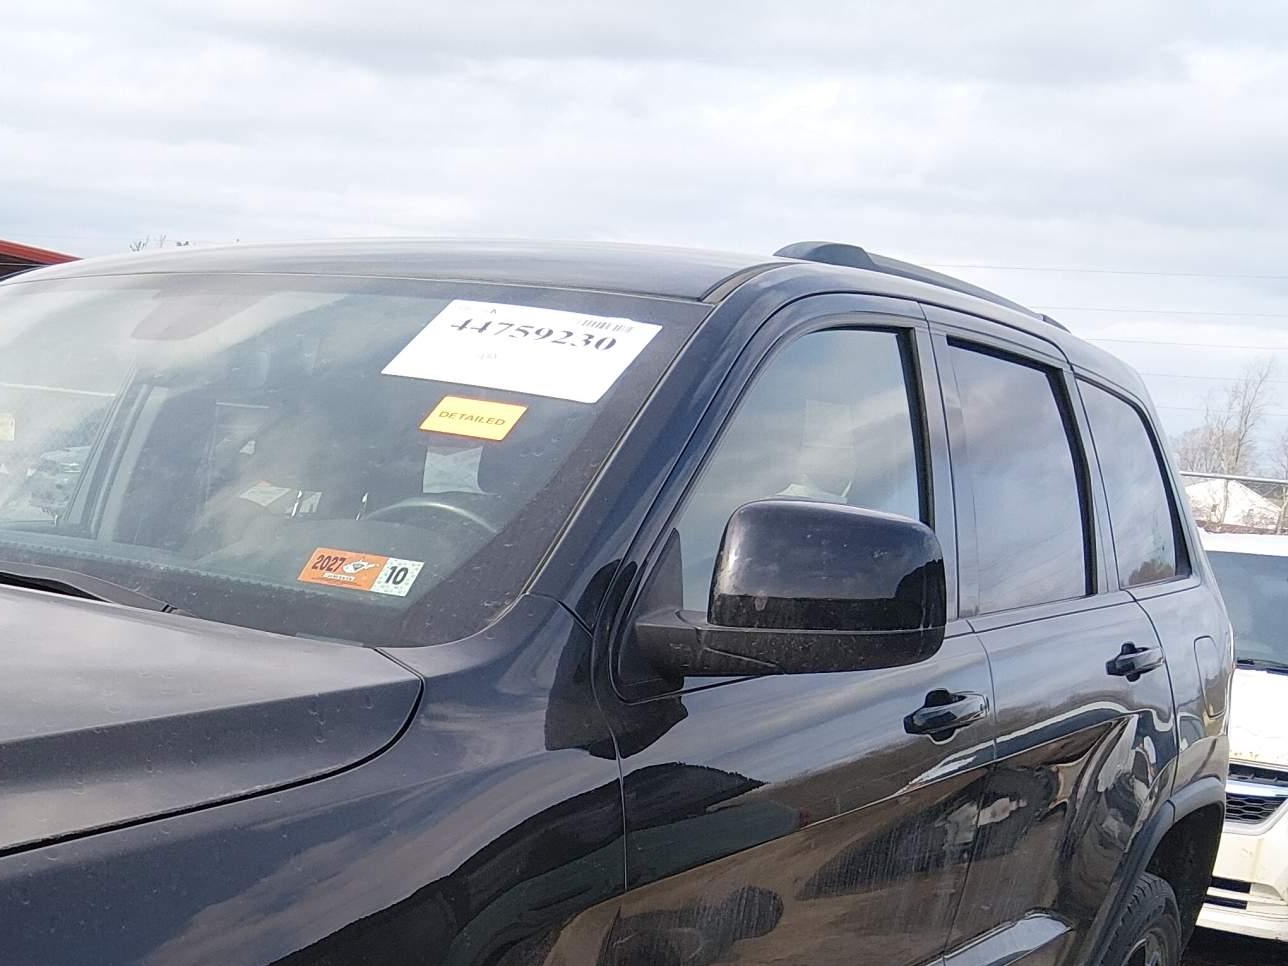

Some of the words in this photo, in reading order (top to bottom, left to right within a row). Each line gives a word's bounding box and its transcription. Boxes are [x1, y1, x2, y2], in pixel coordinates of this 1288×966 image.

[450, 317, 617, 352] 44759230
[438, 410, 507, 427] DETAILED
[311, 554, 347, 573] 2027
[384, 565, 410, 586] 10
